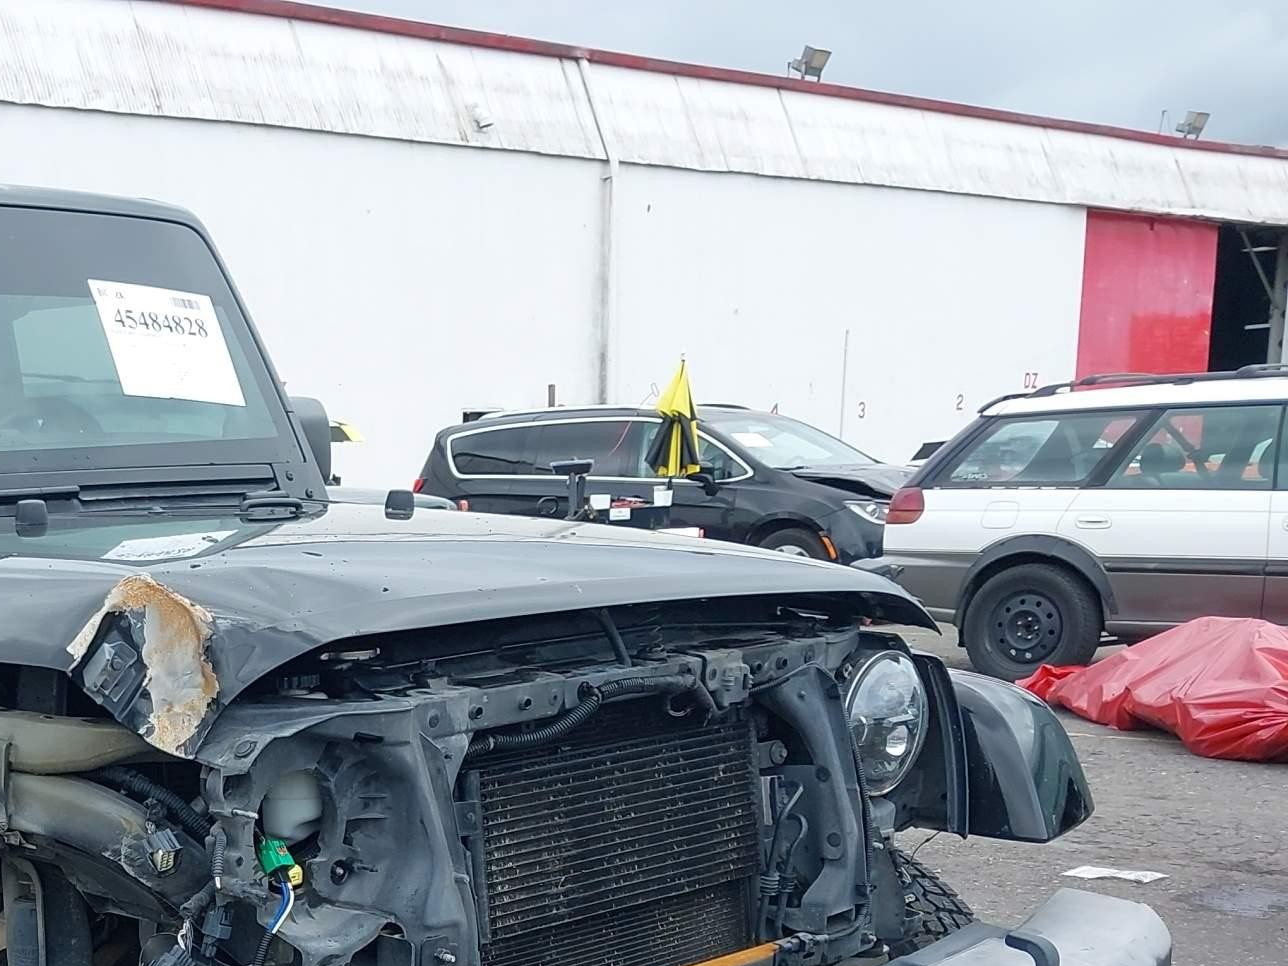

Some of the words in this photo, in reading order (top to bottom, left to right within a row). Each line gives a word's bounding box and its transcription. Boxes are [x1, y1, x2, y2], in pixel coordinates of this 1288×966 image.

[114, 307, 208, 338] 45484828
[858, 401, 866, 418] 3
[956, 393, 964, 410] 2
